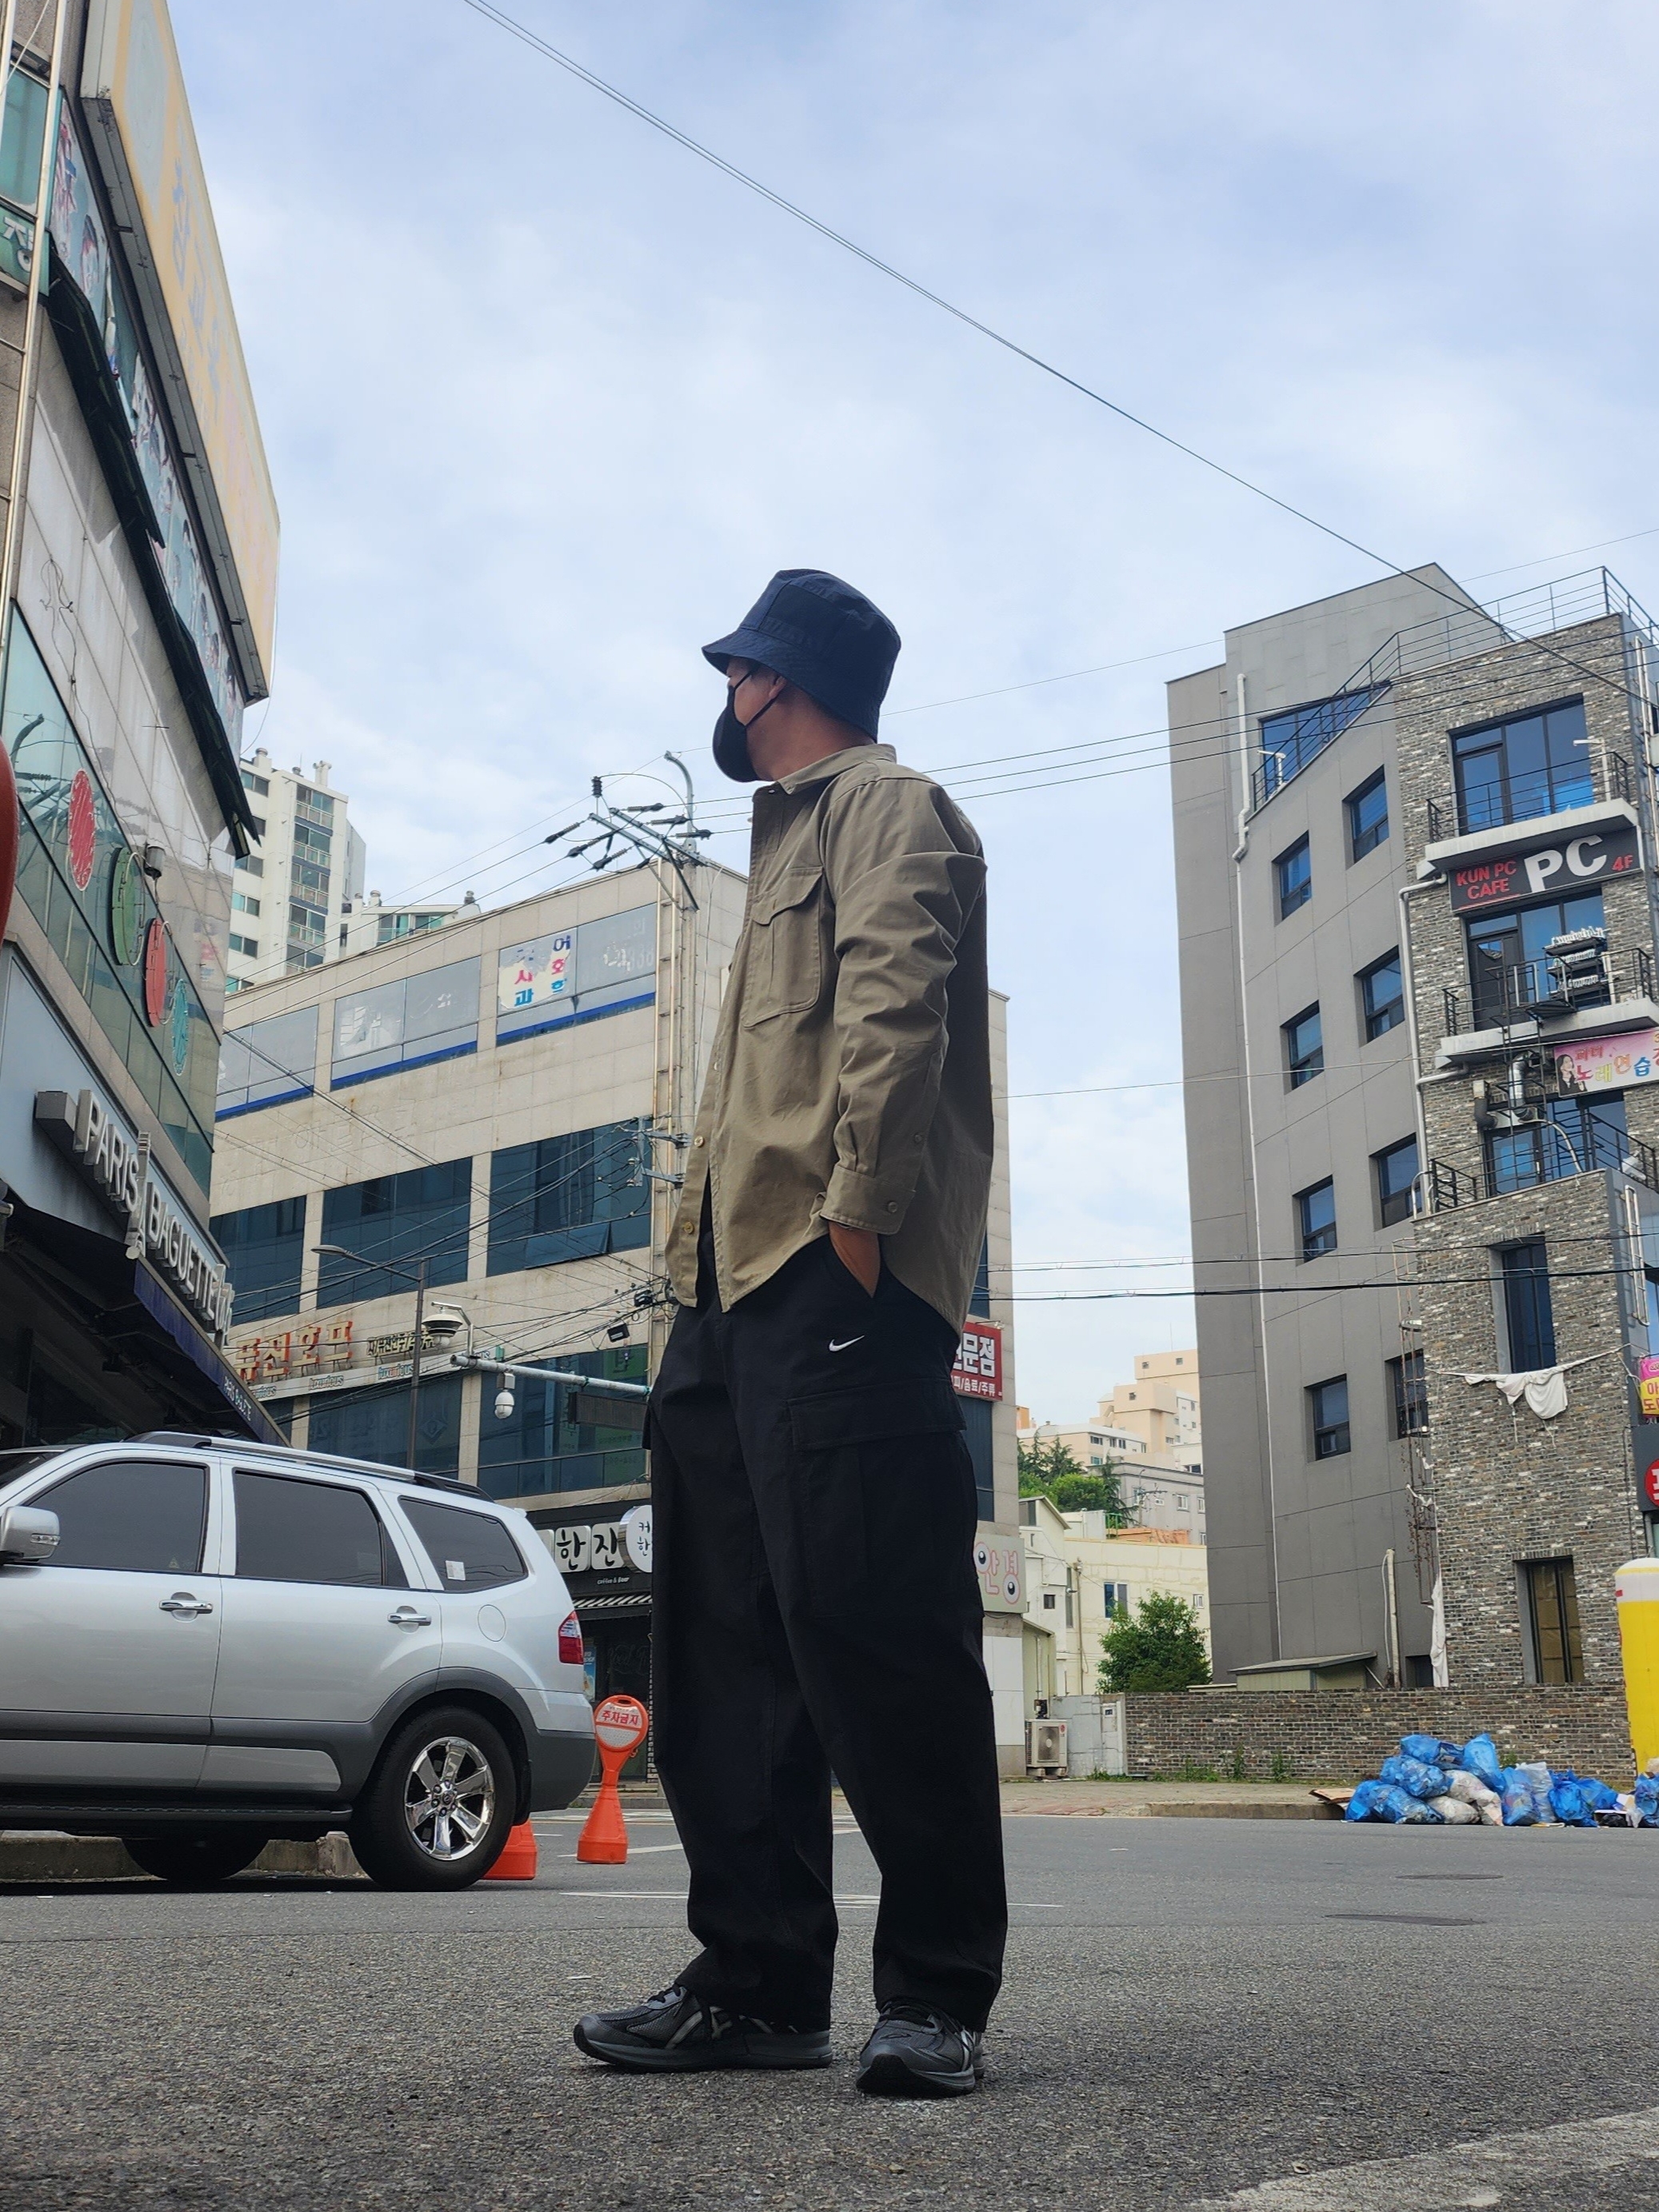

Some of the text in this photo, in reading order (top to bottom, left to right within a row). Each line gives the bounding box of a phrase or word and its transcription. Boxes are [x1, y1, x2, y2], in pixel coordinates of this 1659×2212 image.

[1457, 860, 1517, 886] KUN PC
[1524, 835, 1608, 893] PC
[1611, 855, 1633, 872] 4F
[1467, 878, 1510, 900] CAFE
[82, 1089, 218, 1320] PARIS BAGUETTE
[973, 1542, 1021, 1605] 안경
[602, 1710, 638, 1726] 주차금지
